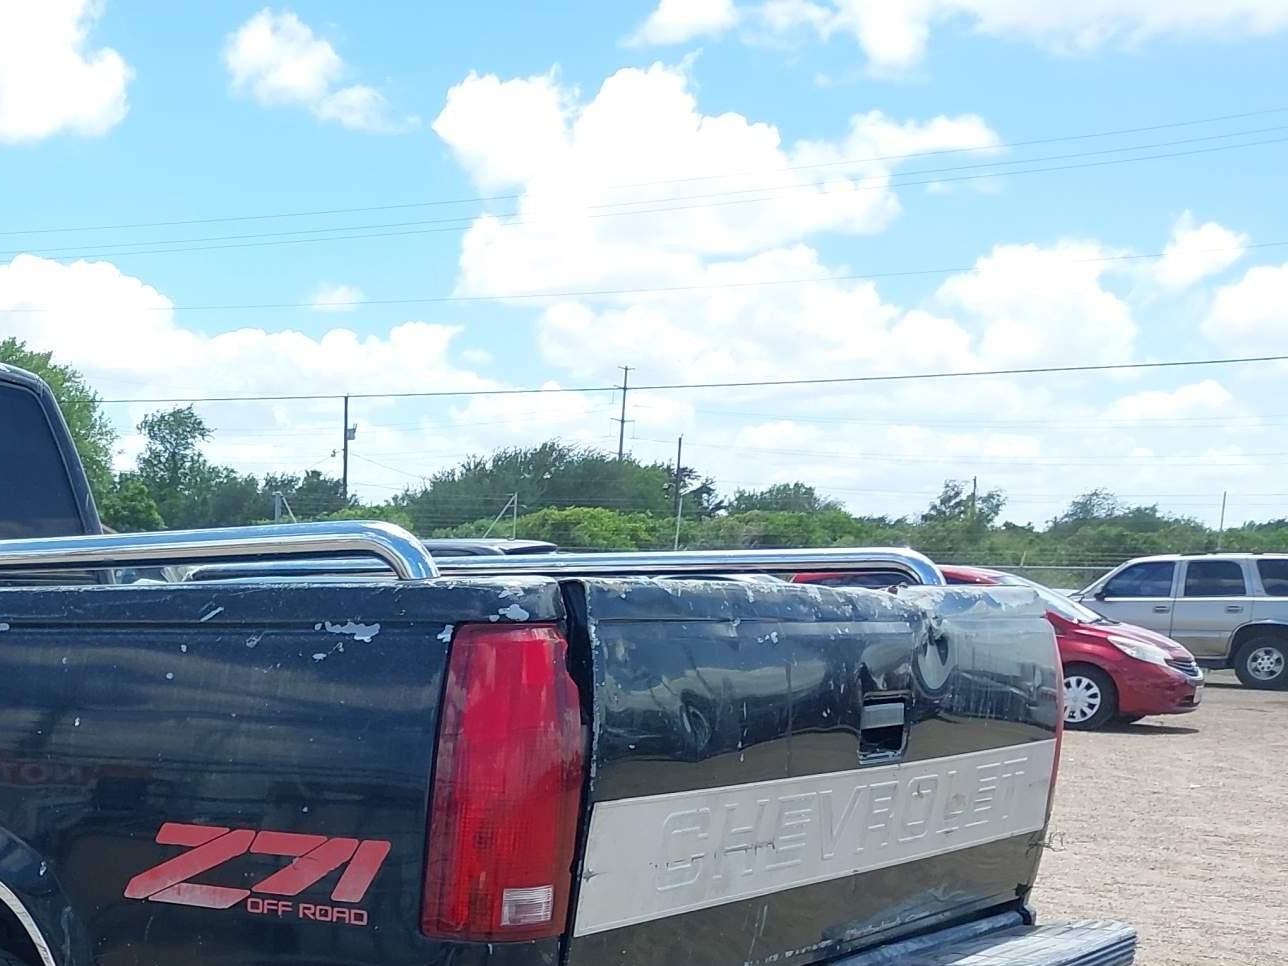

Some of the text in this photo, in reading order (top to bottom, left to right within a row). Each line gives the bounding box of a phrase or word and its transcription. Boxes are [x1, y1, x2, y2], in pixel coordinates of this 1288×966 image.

[123, 821, 392, 909] Z71
[655, 755, 1028, 893] CHEVROLET
[247, 898, 369, 927] OFF ROAD
